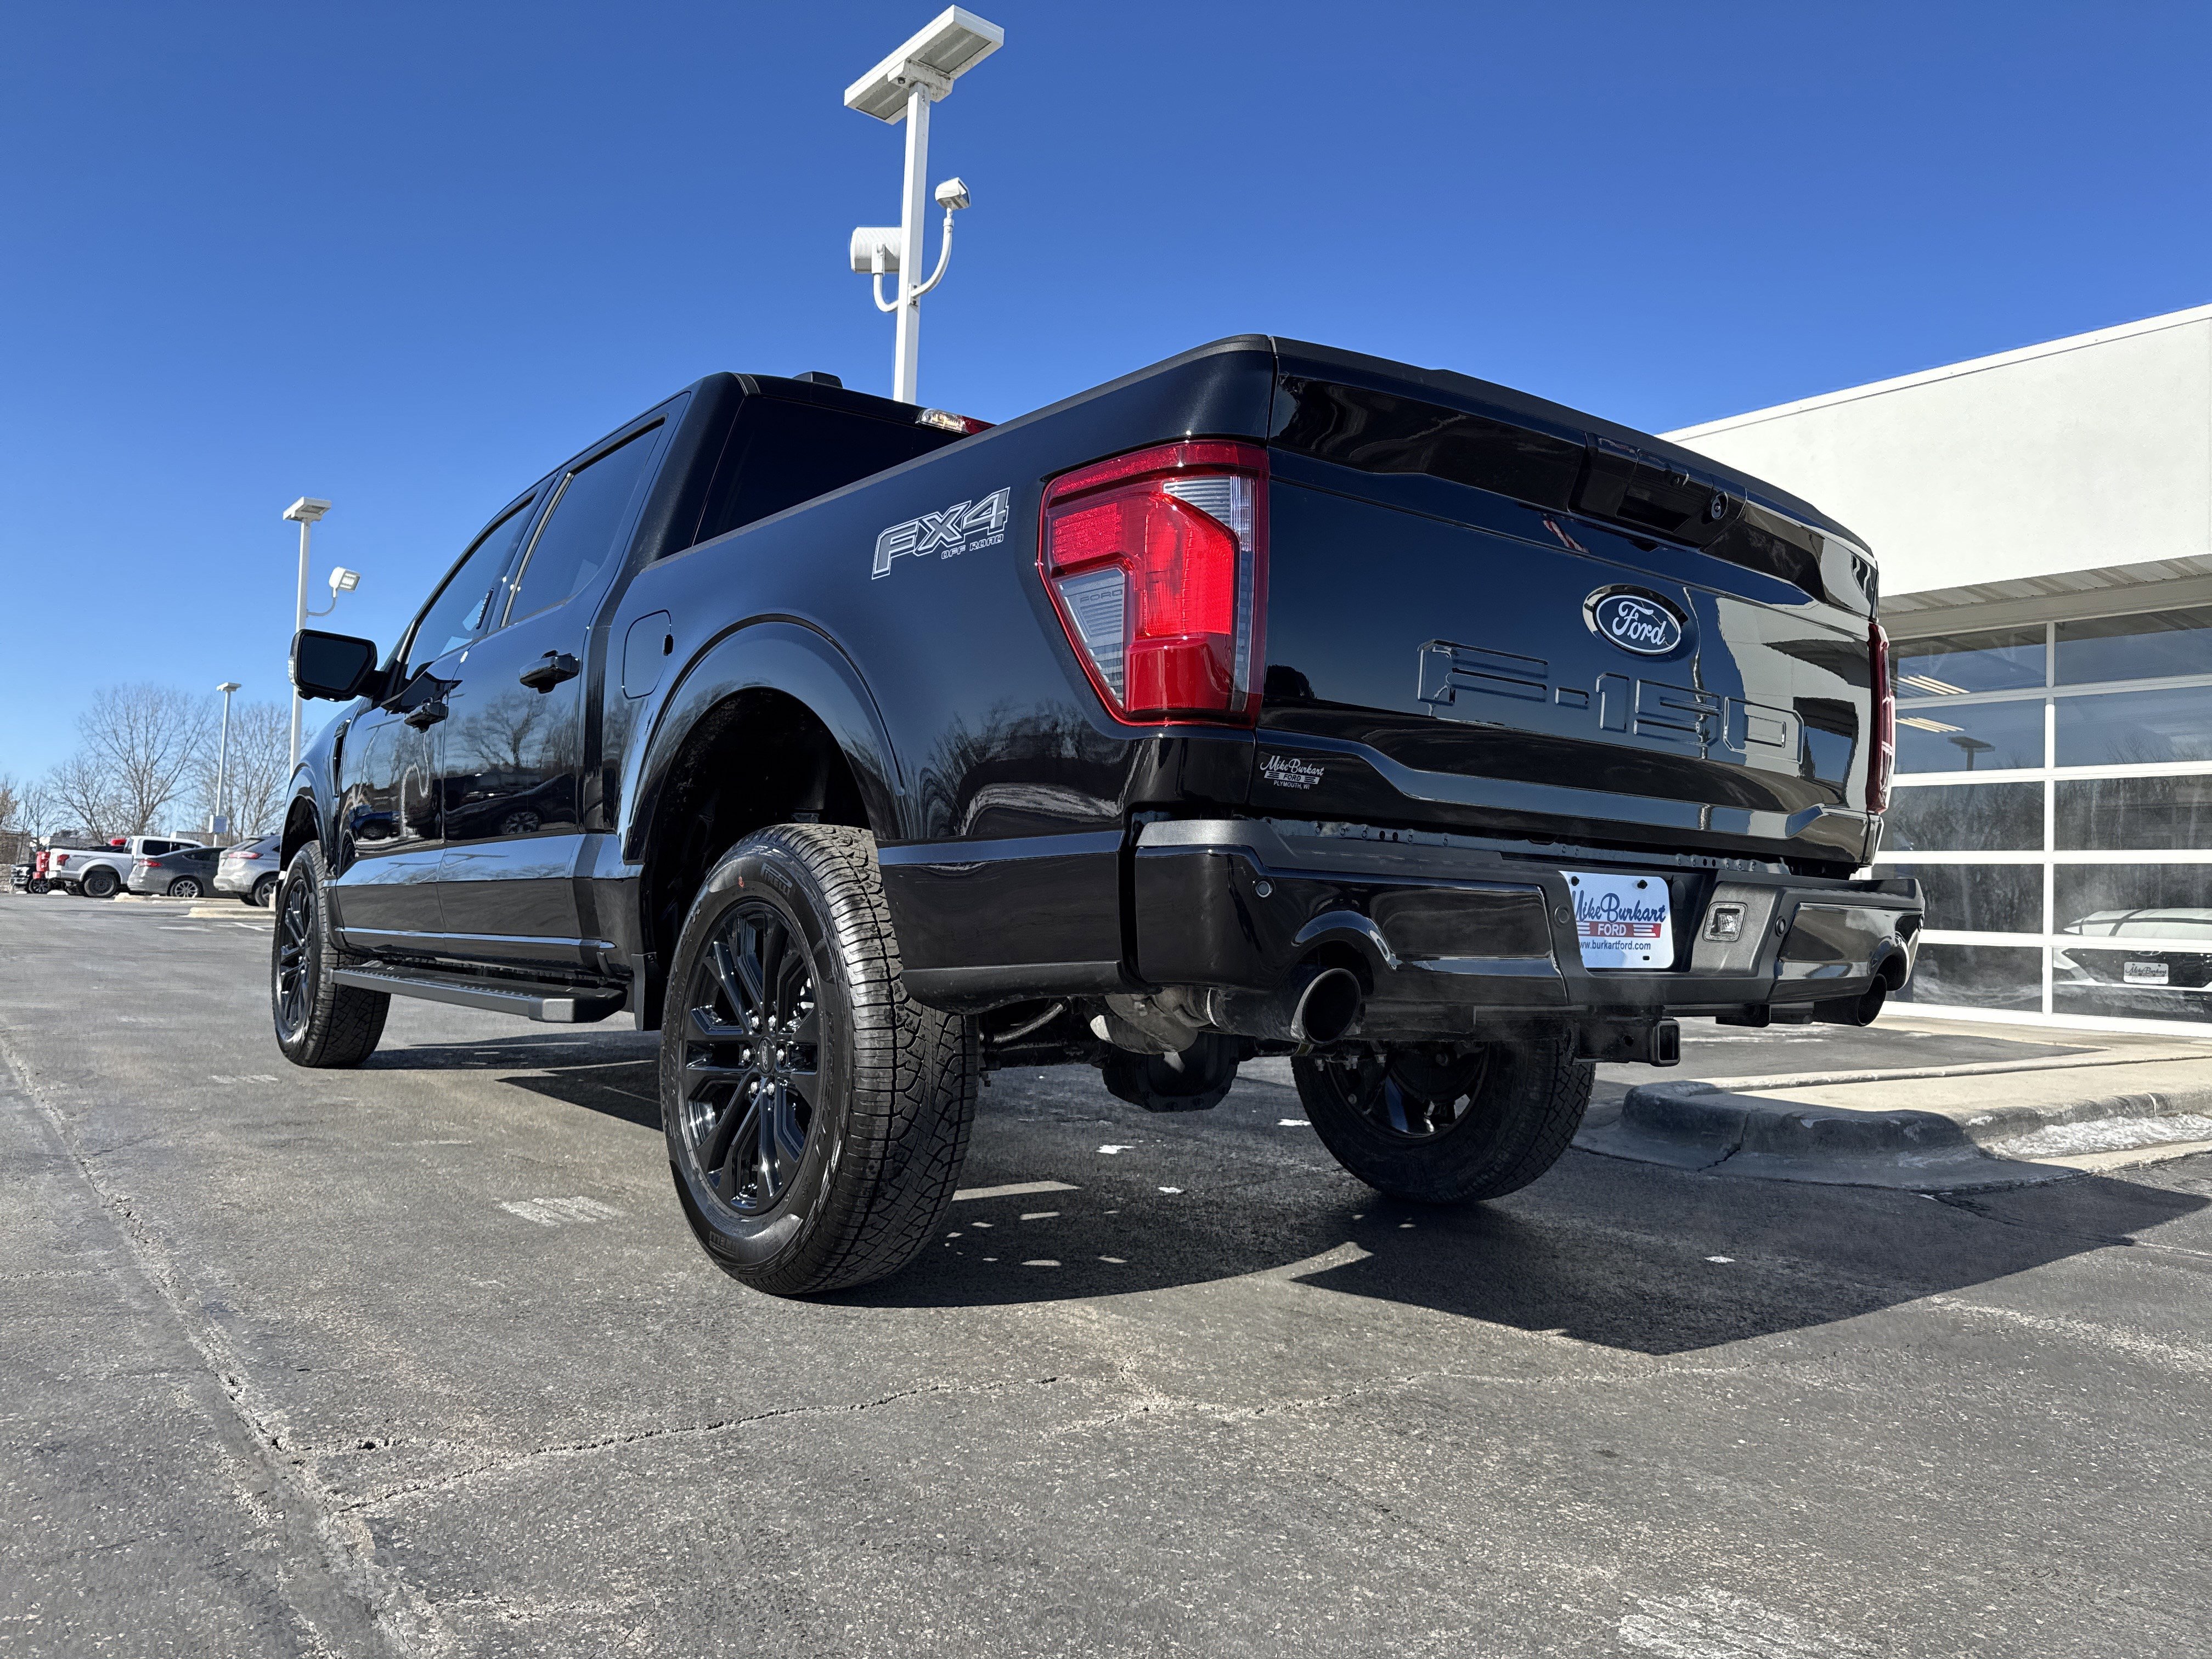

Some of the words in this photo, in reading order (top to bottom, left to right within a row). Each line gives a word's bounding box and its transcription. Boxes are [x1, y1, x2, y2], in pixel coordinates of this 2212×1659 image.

[872, 487, 1011, 580] FX4
[941, 545, 966, 560] OFF
[969, 533, 1004, 551] ROAD
[1079, 589, 1123, 603] FORD
[1612, 601, 1666, 646] Ford
[1417, 639, 1804, 764] F-150
[1260, 755, 1289, 771] Mike
[1289, 758, 1324, 776] Burkart
[1273, 780, 1302, 790] PLYMOUTH,
[760, 862, 793, 899] PIRELLI
[1600, 893, 1666, 923] Burkart
[1597, 923, 1627, 936] FORD
[1579, 939, 1651, 950] ww.burkartford.com
